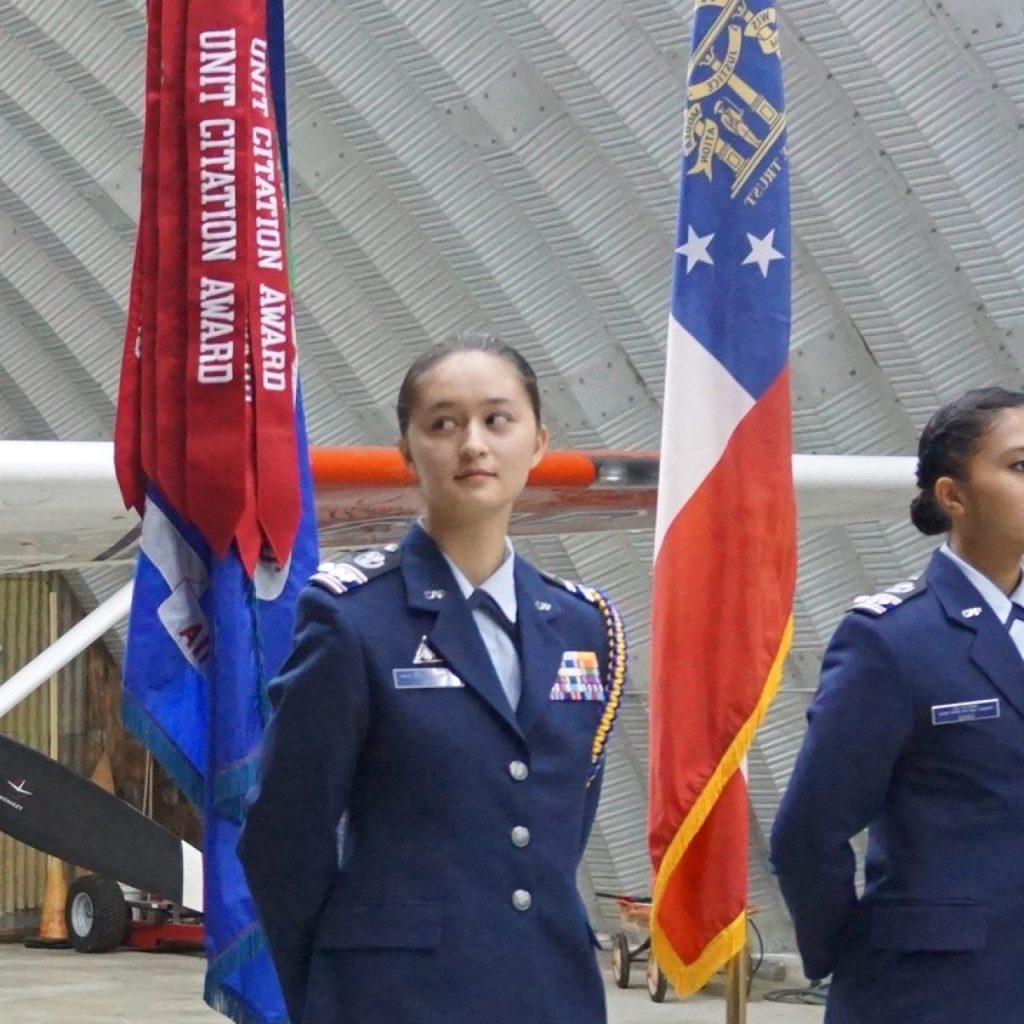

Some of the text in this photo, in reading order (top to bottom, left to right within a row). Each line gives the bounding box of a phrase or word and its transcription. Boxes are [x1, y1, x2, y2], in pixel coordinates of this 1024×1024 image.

[198, 28, 236, 384] UNIT CITATION AWARD
[250, 37, 286, 391] UNIT CITATION AWARD
